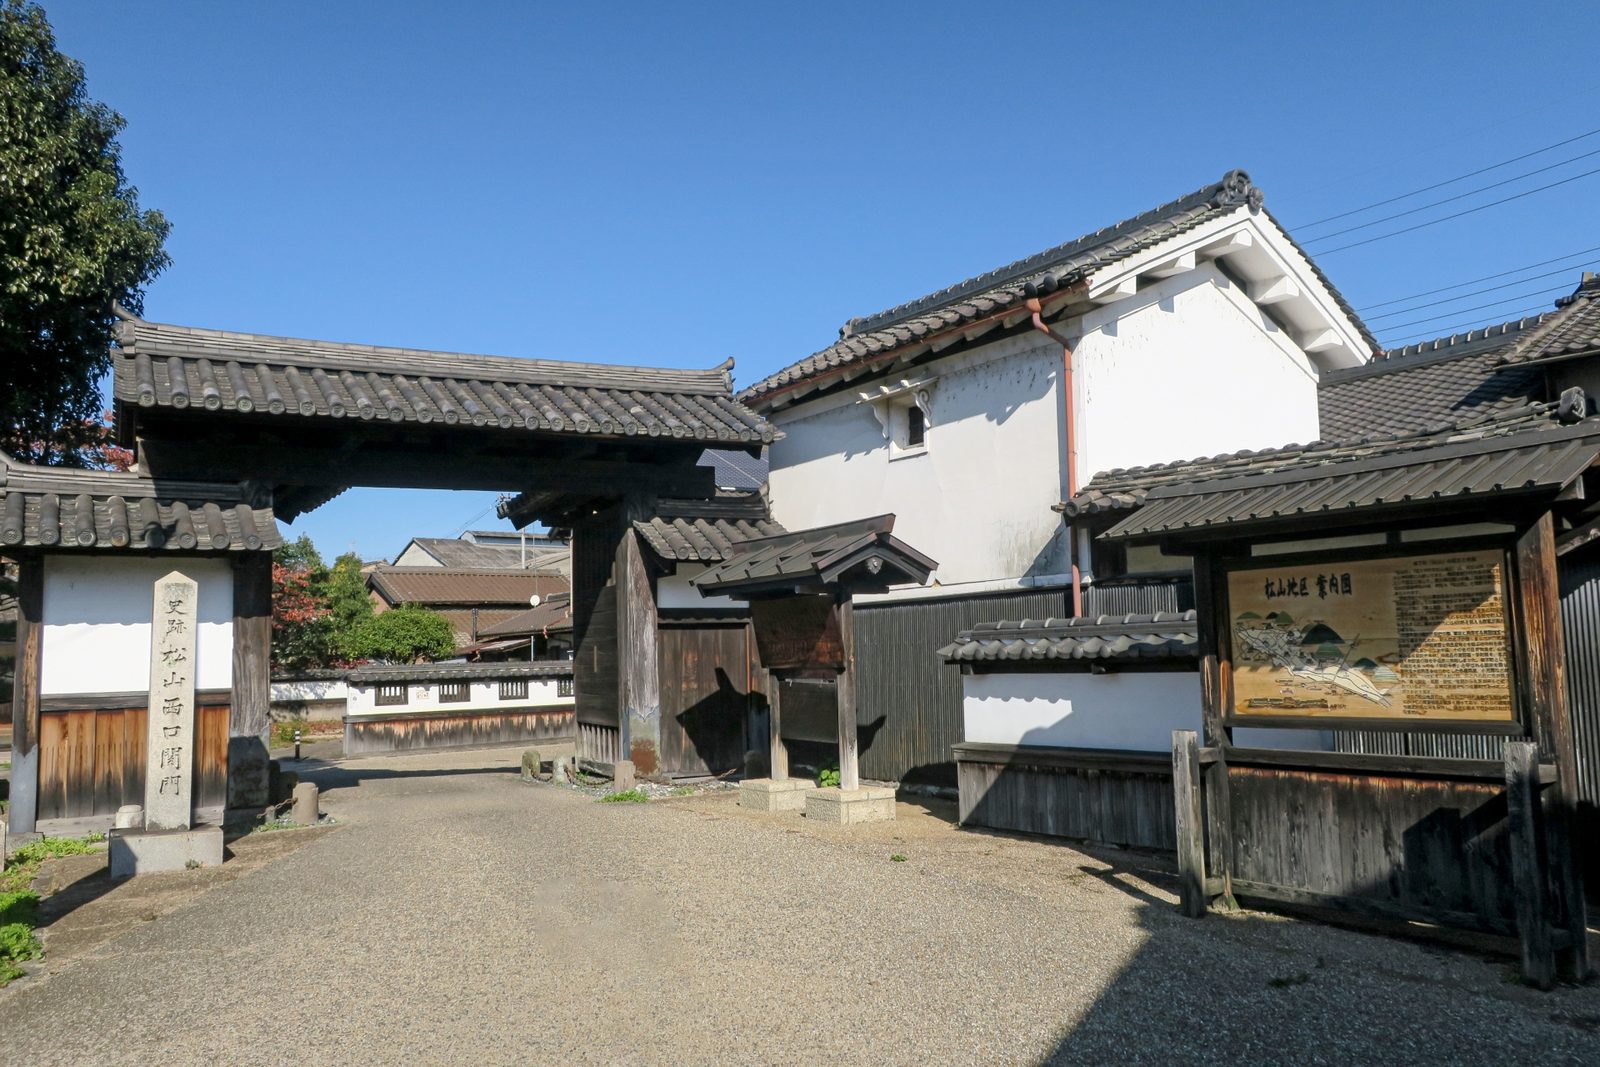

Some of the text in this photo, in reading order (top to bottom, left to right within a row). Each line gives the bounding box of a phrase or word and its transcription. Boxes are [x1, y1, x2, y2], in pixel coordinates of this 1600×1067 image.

[1265, 572, 1352, 600] 松山地区 案内図
